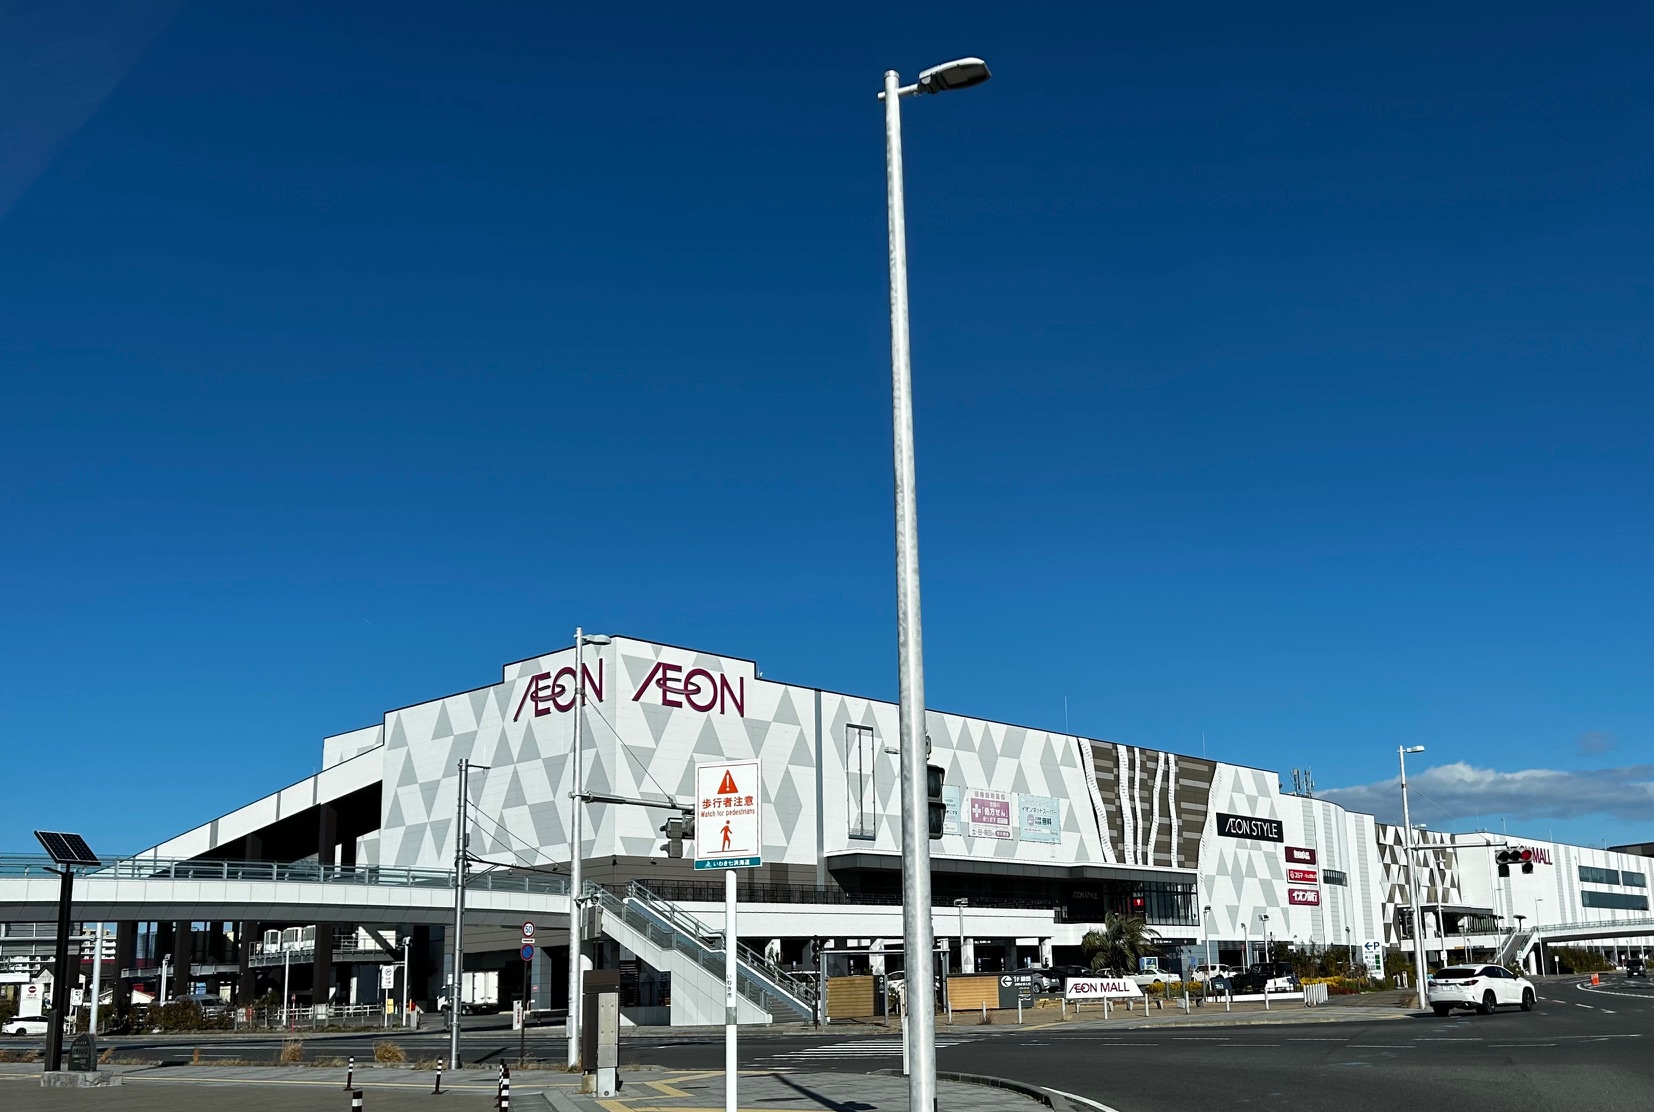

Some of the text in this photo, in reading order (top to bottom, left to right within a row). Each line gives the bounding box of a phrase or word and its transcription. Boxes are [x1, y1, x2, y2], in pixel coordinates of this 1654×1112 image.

[702, 795, 754, 809] 歩行者注意
[726, 808, 755, 817] pedestrians
[1252, 820, 1278, 838] STYLE
[1532, 846, 1553, 865] MALL
[525, 926, 532, 934] 50
[1373, 941, 1380, 950] P
[1100, 981, 1130, 993] MALL
